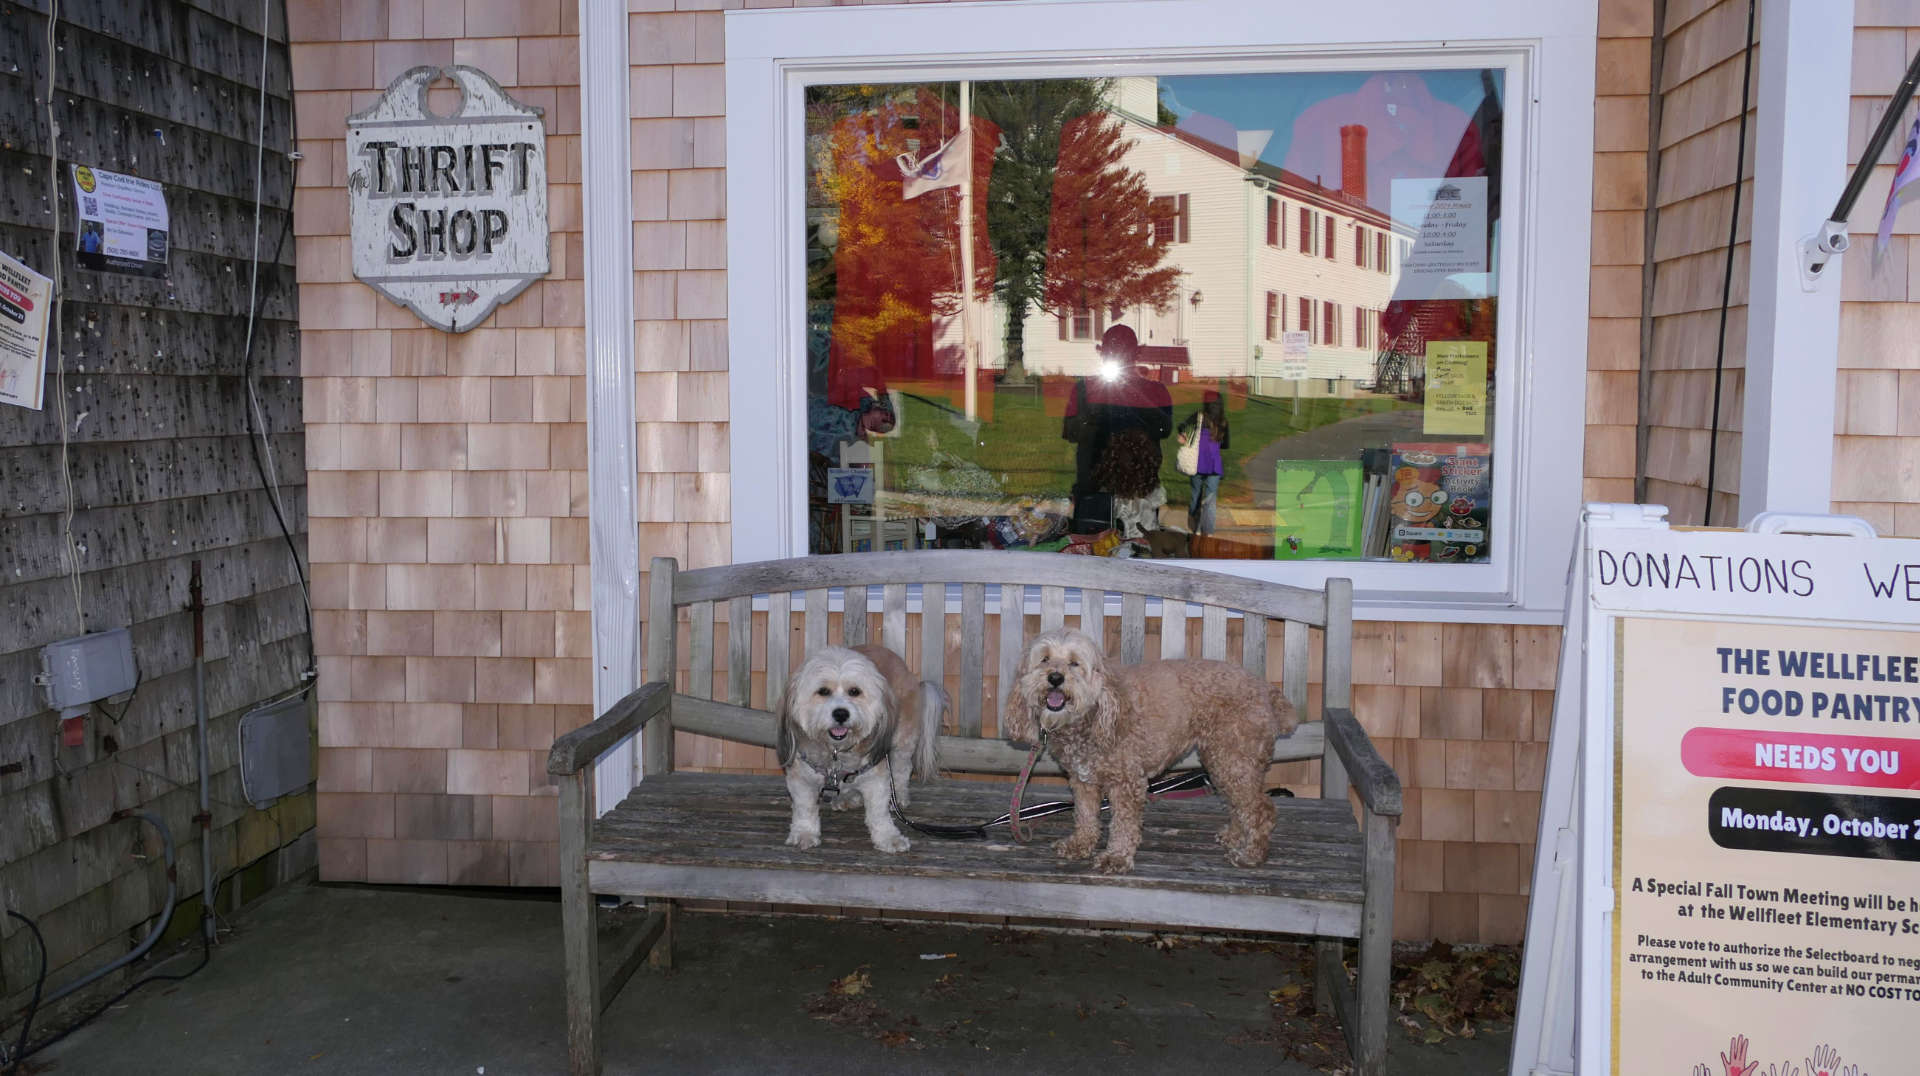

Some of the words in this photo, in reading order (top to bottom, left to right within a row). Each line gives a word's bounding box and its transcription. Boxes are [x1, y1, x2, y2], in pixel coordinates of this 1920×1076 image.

[363, 141, 537, 194] THRIFT
[389, 202, 510, 260] SHOP
[1441, 465, 1481, 476] Sticker
[1448, 456, 1478, 466] Giant
[1598, 550, 1814, 596] DONATIONS
[1864, 562, 1920, 601] WE
[1717, 647, 1770, 676] THE
[1778, 650, 1920, 684] WELLFLEE
[1722, 687, 1803, 717] FOOD
[1755, 742, 1836, 771] NEEDS
[1842, 747, 1899, 774] YOU
[1721, 807, 1819, 837] Monday,
[1823, 814, 1909, 840] October
[1632, 877, 1643, 892] A
[1647, 878, 1701, 898] Special
[1706, 882, 1732, 898] Fall
[1737, 885, 1778, 902] Town
[1783, 888, 1849, 910] Meeting
[1854, 894, 1882, 910] will
[1887, 896, 1905, 912] be
[1678, 904, 1693, 916] at
[1701, 904, 1725, 919] the
[1729, 906, 1801, 926] Wellfleet
[1806, 912, 1897, 936] Elementary
[1629, 953, 1706, 969] arrangement
[1710, 957, 1736, 970] with
[1740, 961, 1753, 972] us
[1756, 962, 1769, 972] so
[1772, 964, 1789, 974] we
[1792, 965, 1813, 976] can
[1817, 964, 1847, 979] build
[1851, 970, 1872, 981] our
[1638, 935, 1676, 949] Please
[1680, 940, 1705, 951] vote
[1709, 941, 1720, 952] to
[1723, 942, 1780, 958] authorize
[1783, 946, 1802, 959] the
[1806, 947, 1879, 965] Selectboard
[1882, 955, 1895, 966] to
[1898, 956, 1920, 972] neg
[1642, 968, 1654, 980] to
[1657, 970, 1675, 981] the
[1678, 970, 1712, 984] Adult
[1714, 974, 1783, 992] Community
[1787, 979, 1827, 994] Center
[1831, 984, 1843, 995] at
[1846, 984, 1865, 997] NO
[1868, 987, 1901, 1000] COST
